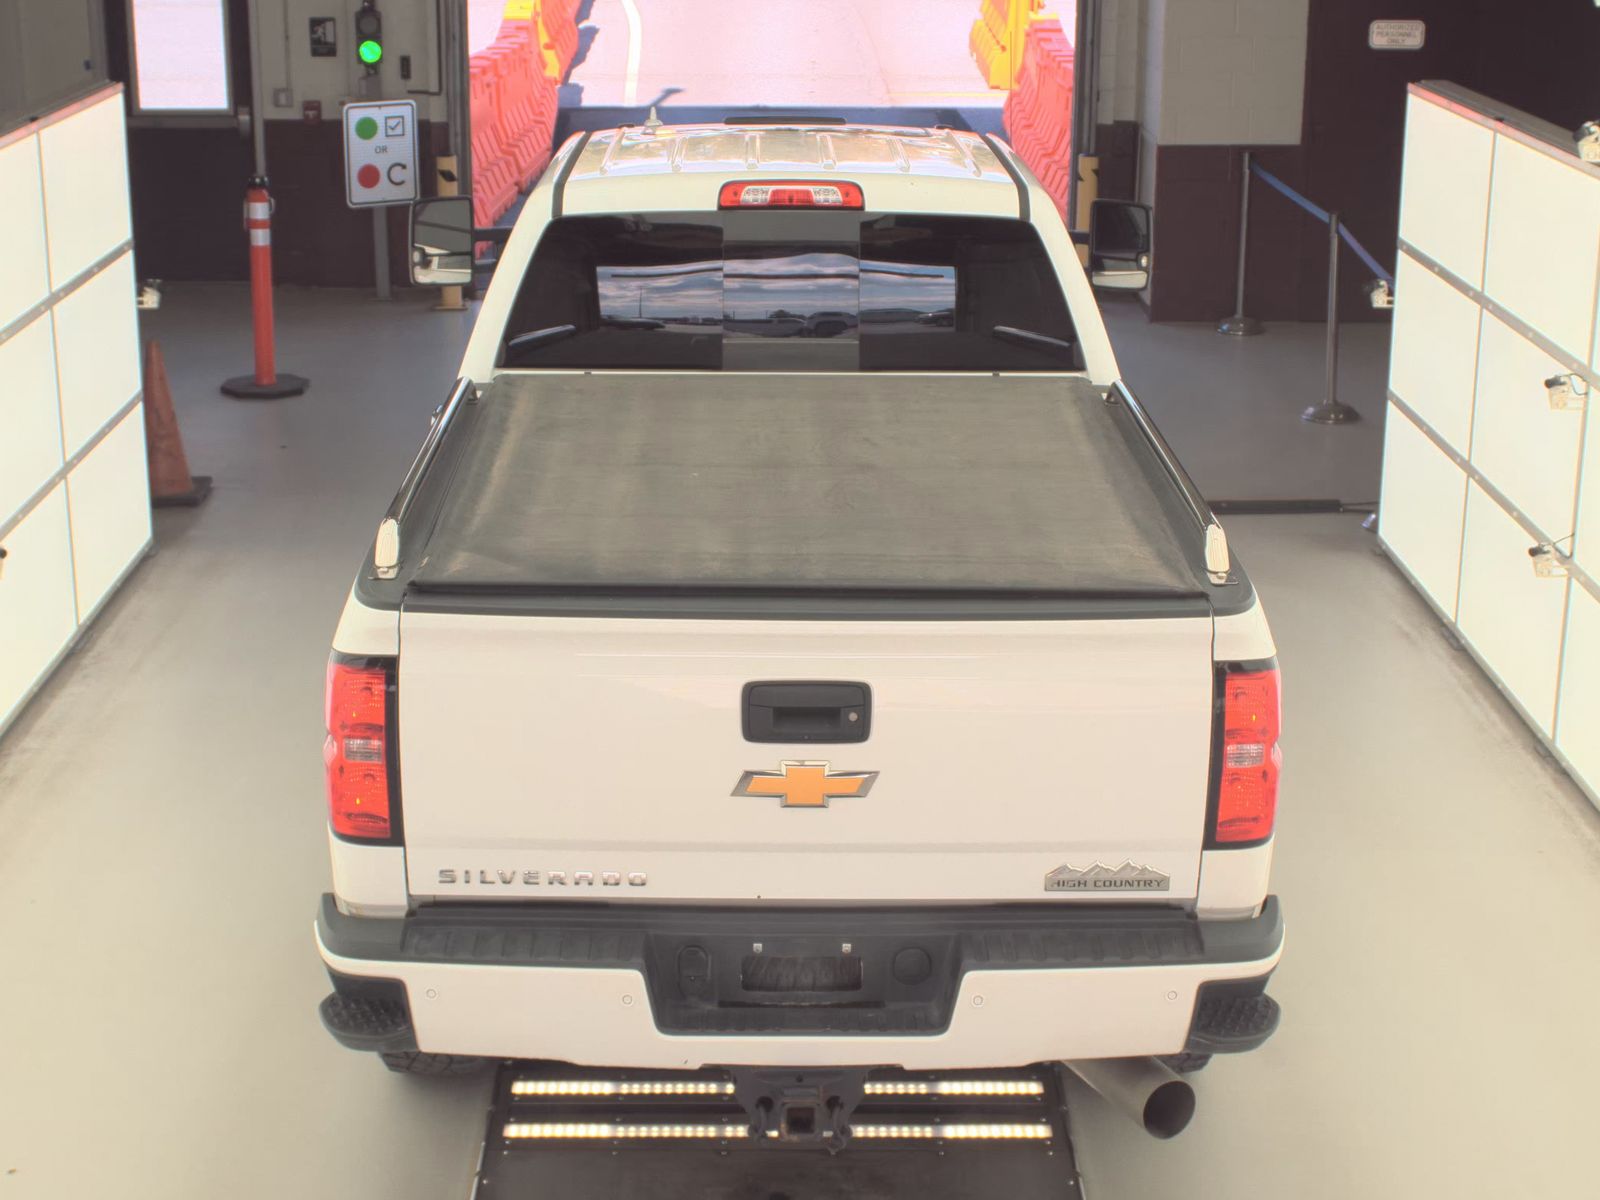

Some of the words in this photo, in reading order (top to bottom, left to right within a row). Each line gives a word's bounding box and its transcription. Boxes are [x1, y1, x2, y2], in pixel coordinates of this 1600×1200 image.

[374, 145, 388, 154] OR
[438, 868, 648, 887] SILVERADO
[1051, 879, 1087, 888] HIGH
[1093, 879, 1164, 888] COUNTRY
